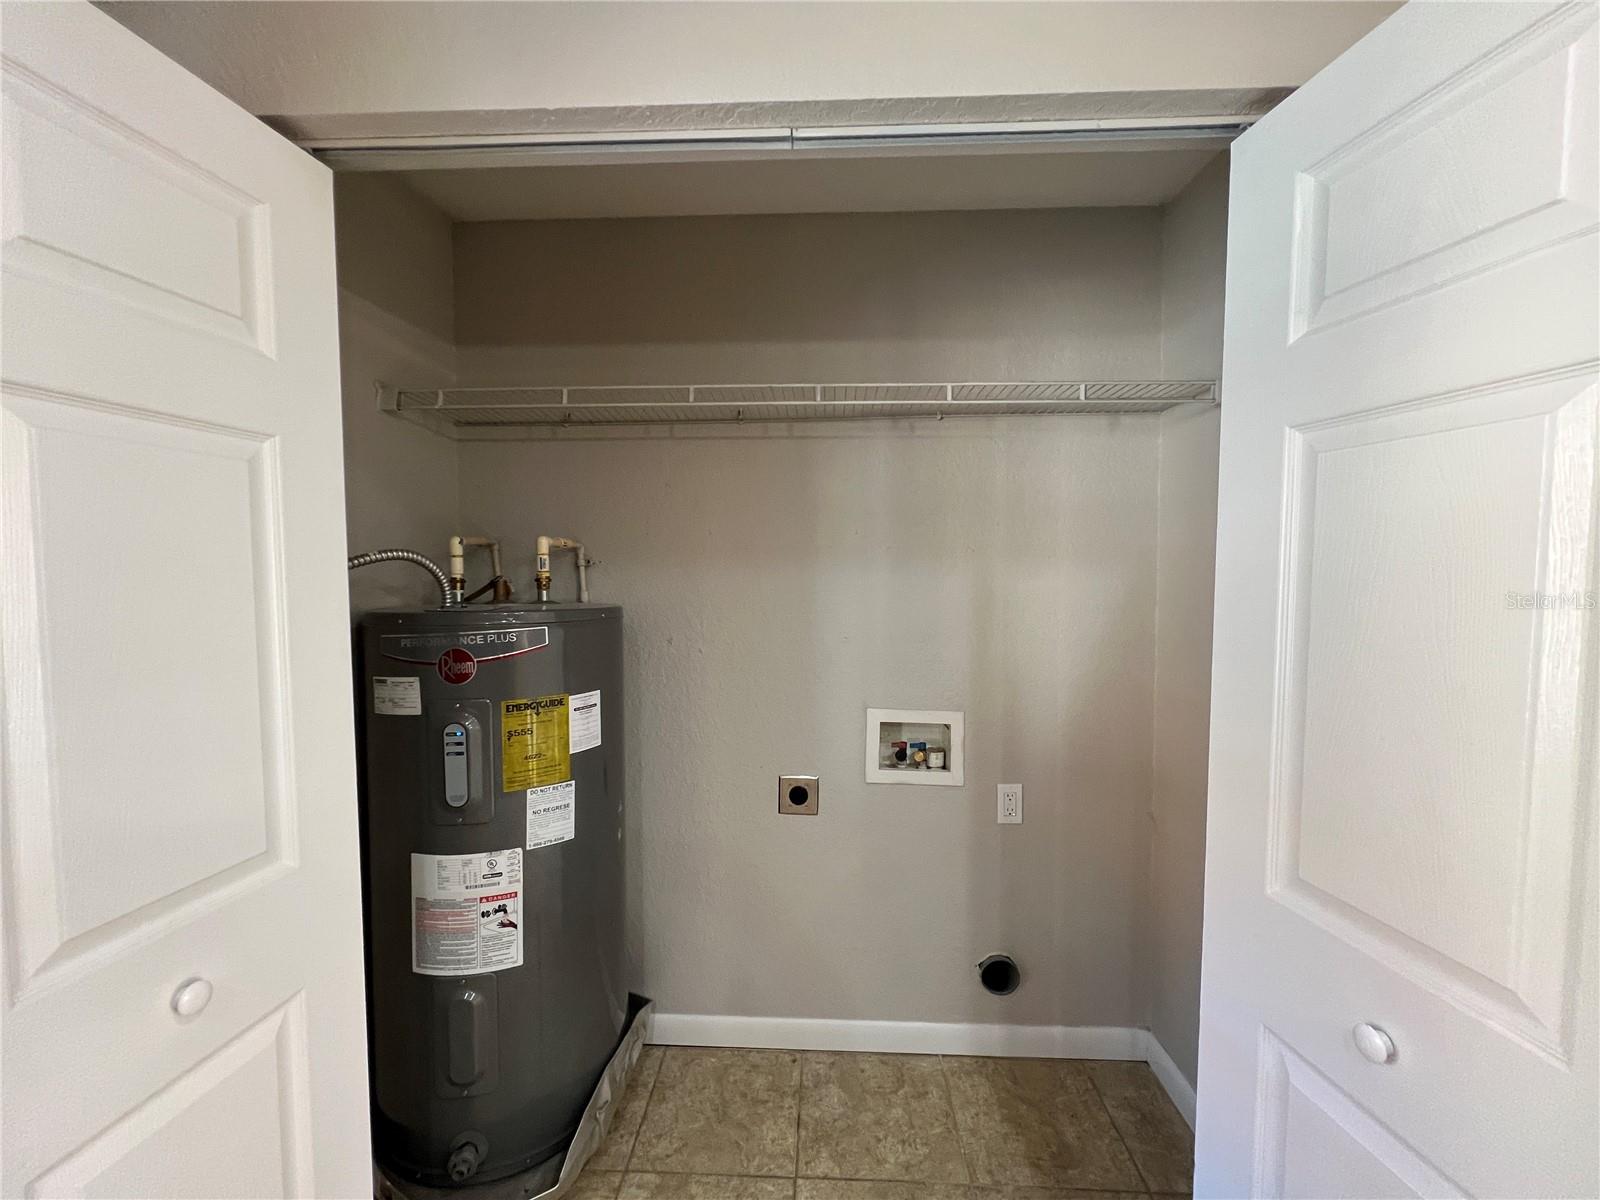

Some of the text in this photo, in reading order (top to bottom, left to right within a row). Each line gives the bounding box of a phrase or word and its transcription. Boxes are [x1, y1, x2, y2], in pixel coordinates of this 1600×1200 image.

[401, 633, 517, 648] PERFORNCE PLUS
[441, 649, 474, 679] Rheem
[506, 727, 533, 738] $555
[530, 783, 573, 796] DO NOT RETURN
[532, 808, 542, 816] NO
[542, 802, 570, 814] REGRESE
[488, 892, 516, 902] DANGER
